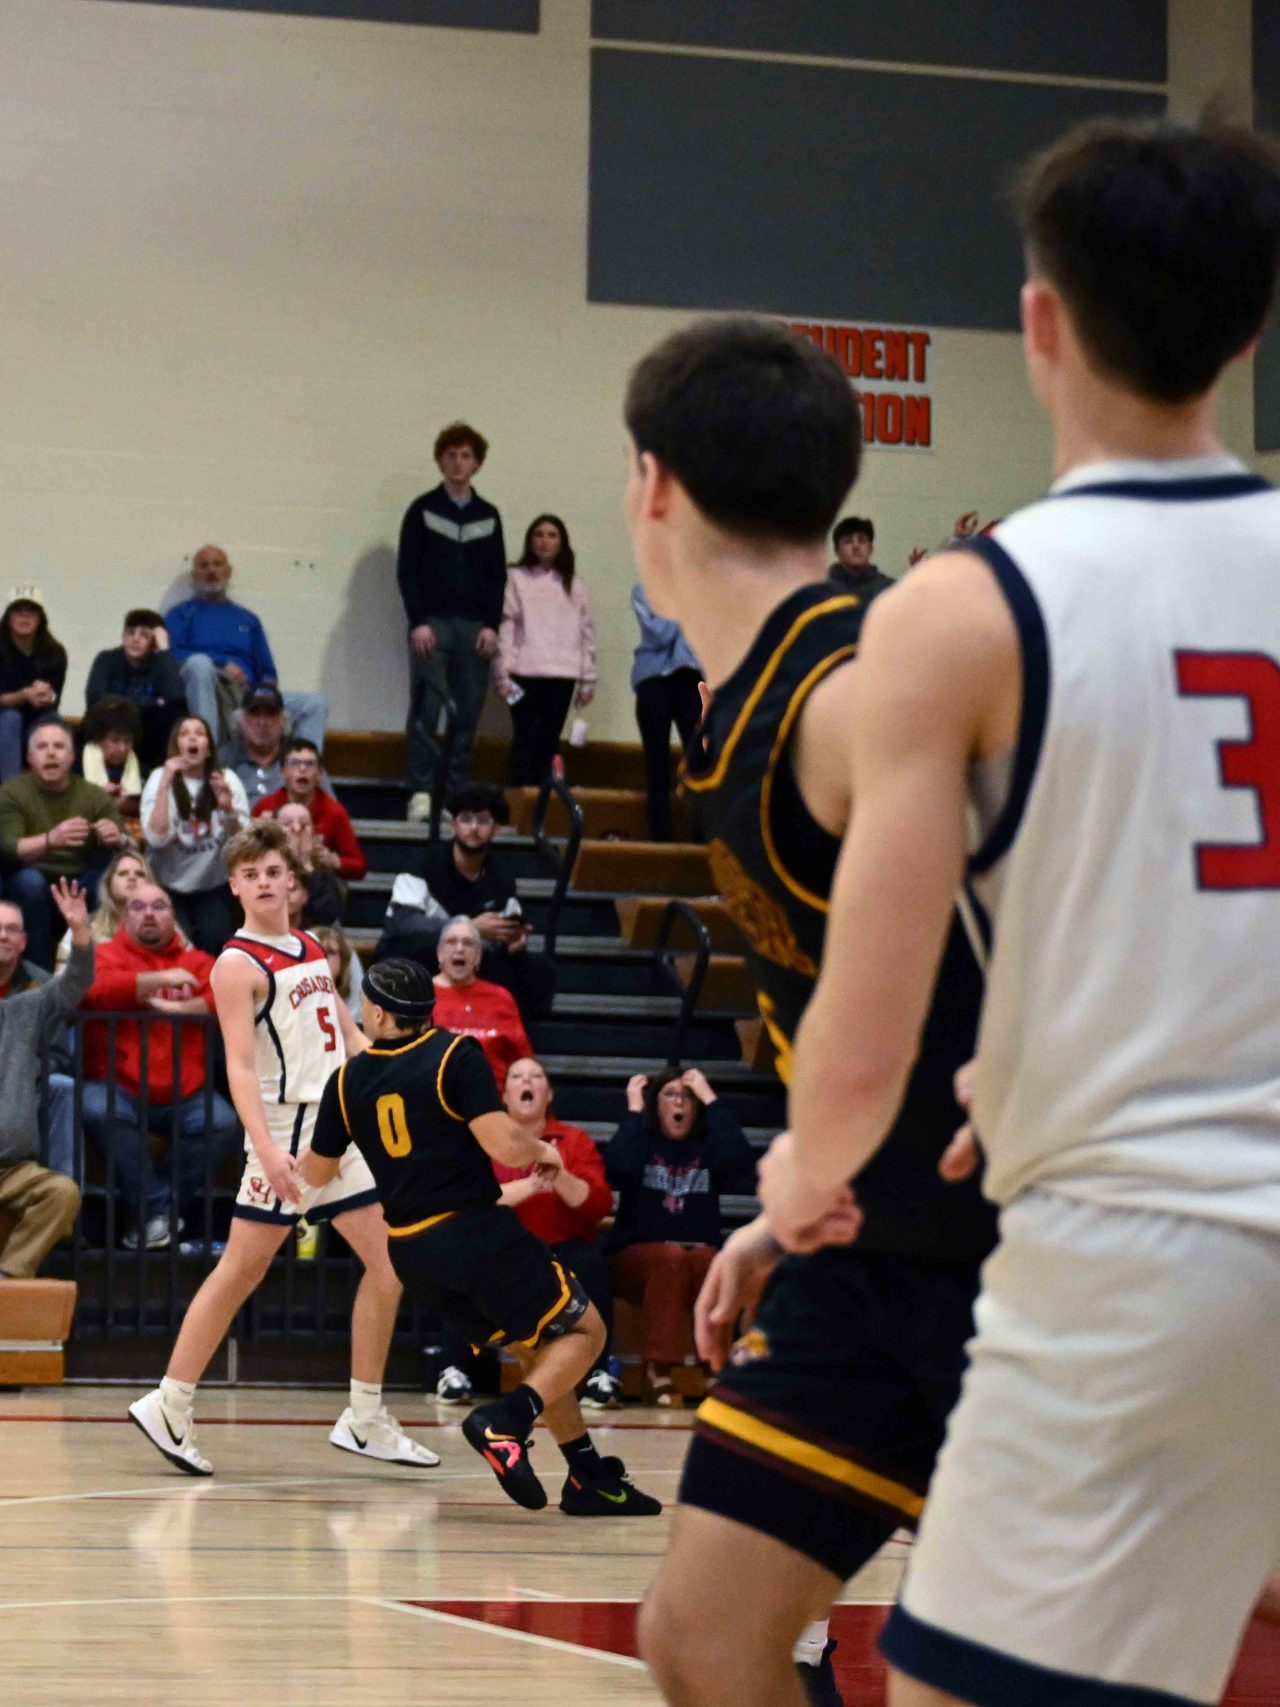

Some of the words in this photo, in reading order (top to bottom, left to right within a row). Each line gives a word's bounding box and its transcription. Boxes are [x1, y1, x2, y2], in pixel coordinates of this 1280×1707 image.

[1173, 648, 1280, 893] 3
[316, 1006, 336, 1052] 5
[375, 1092, 412, 1158] 0
